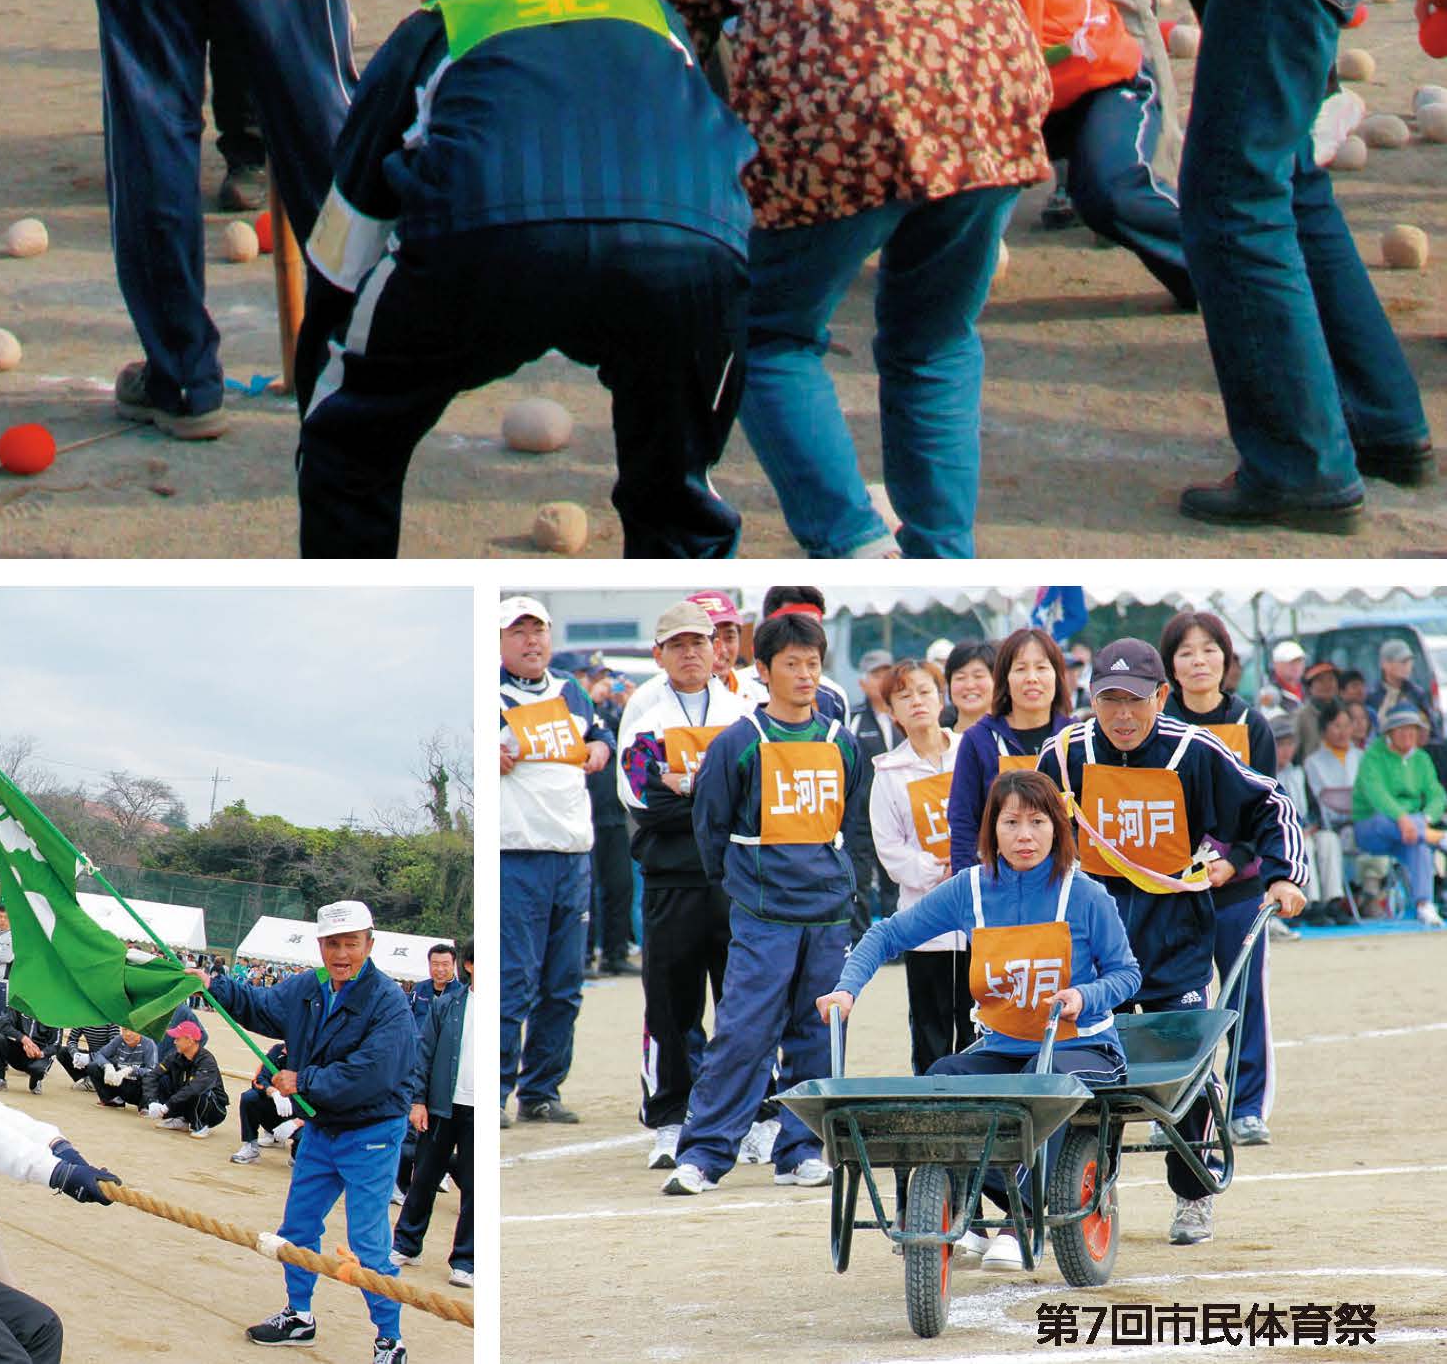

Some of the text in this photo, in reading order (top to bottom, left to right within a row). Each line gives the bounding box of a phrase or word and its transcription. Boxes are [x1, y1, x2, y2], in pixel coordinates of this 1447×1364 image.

[522, 721, 577, 760] 上河戸
[770, 768, 839, 816] 上河戸
[1089, 797, 1176, 850] 上河戸
[985, 957, 1064, 1009] 上河戸
